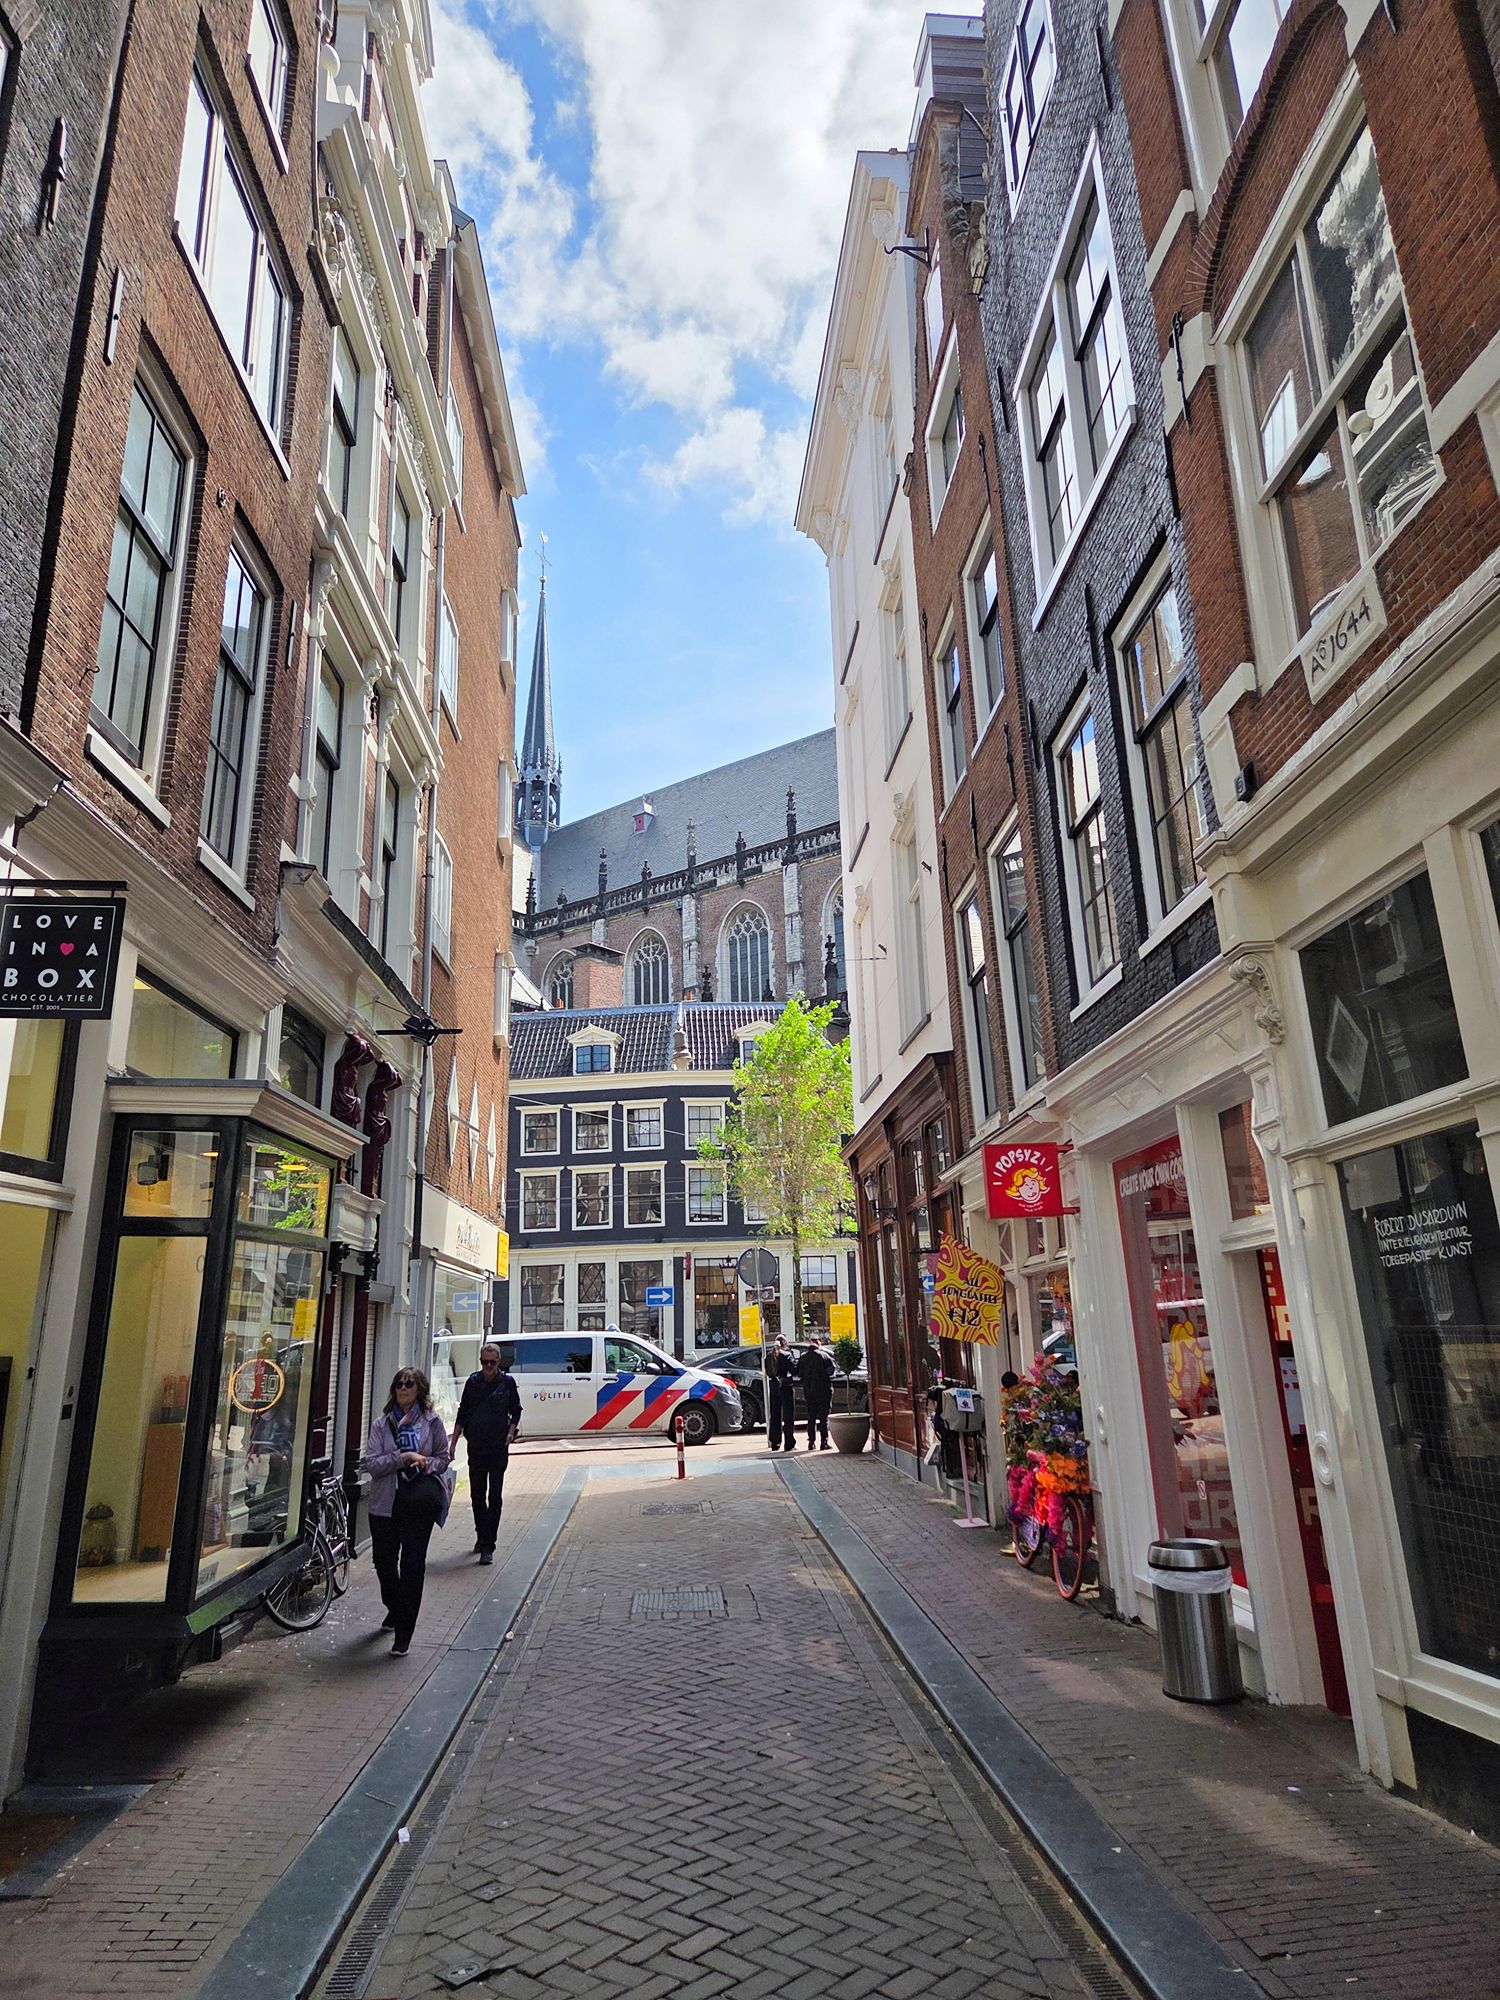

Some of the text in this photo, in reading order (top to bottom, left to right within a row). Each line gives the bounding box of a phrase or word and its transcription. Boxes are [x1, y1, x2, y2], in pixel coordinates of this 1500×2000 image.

[12, 914, 104, 930] LOVE
[8, 941, 99, 956] IN A
[3, 967, 96, 989] BOX
[1, 993, 94, 1003] CHOCOLATIER
[994, 1148, 1041, 1173] POPSYZ
[1139, 1167, 1155, 1192] YOUR
[1373, 1216, 1405, 1238] ROBERT
[1437, 1241, 1473, 1260] KUNST
[964, 1277, 980, 1287] ALL
[947, 1306, 980, 1327] €12
[533, 1391, 573, 1401] POLITIE
